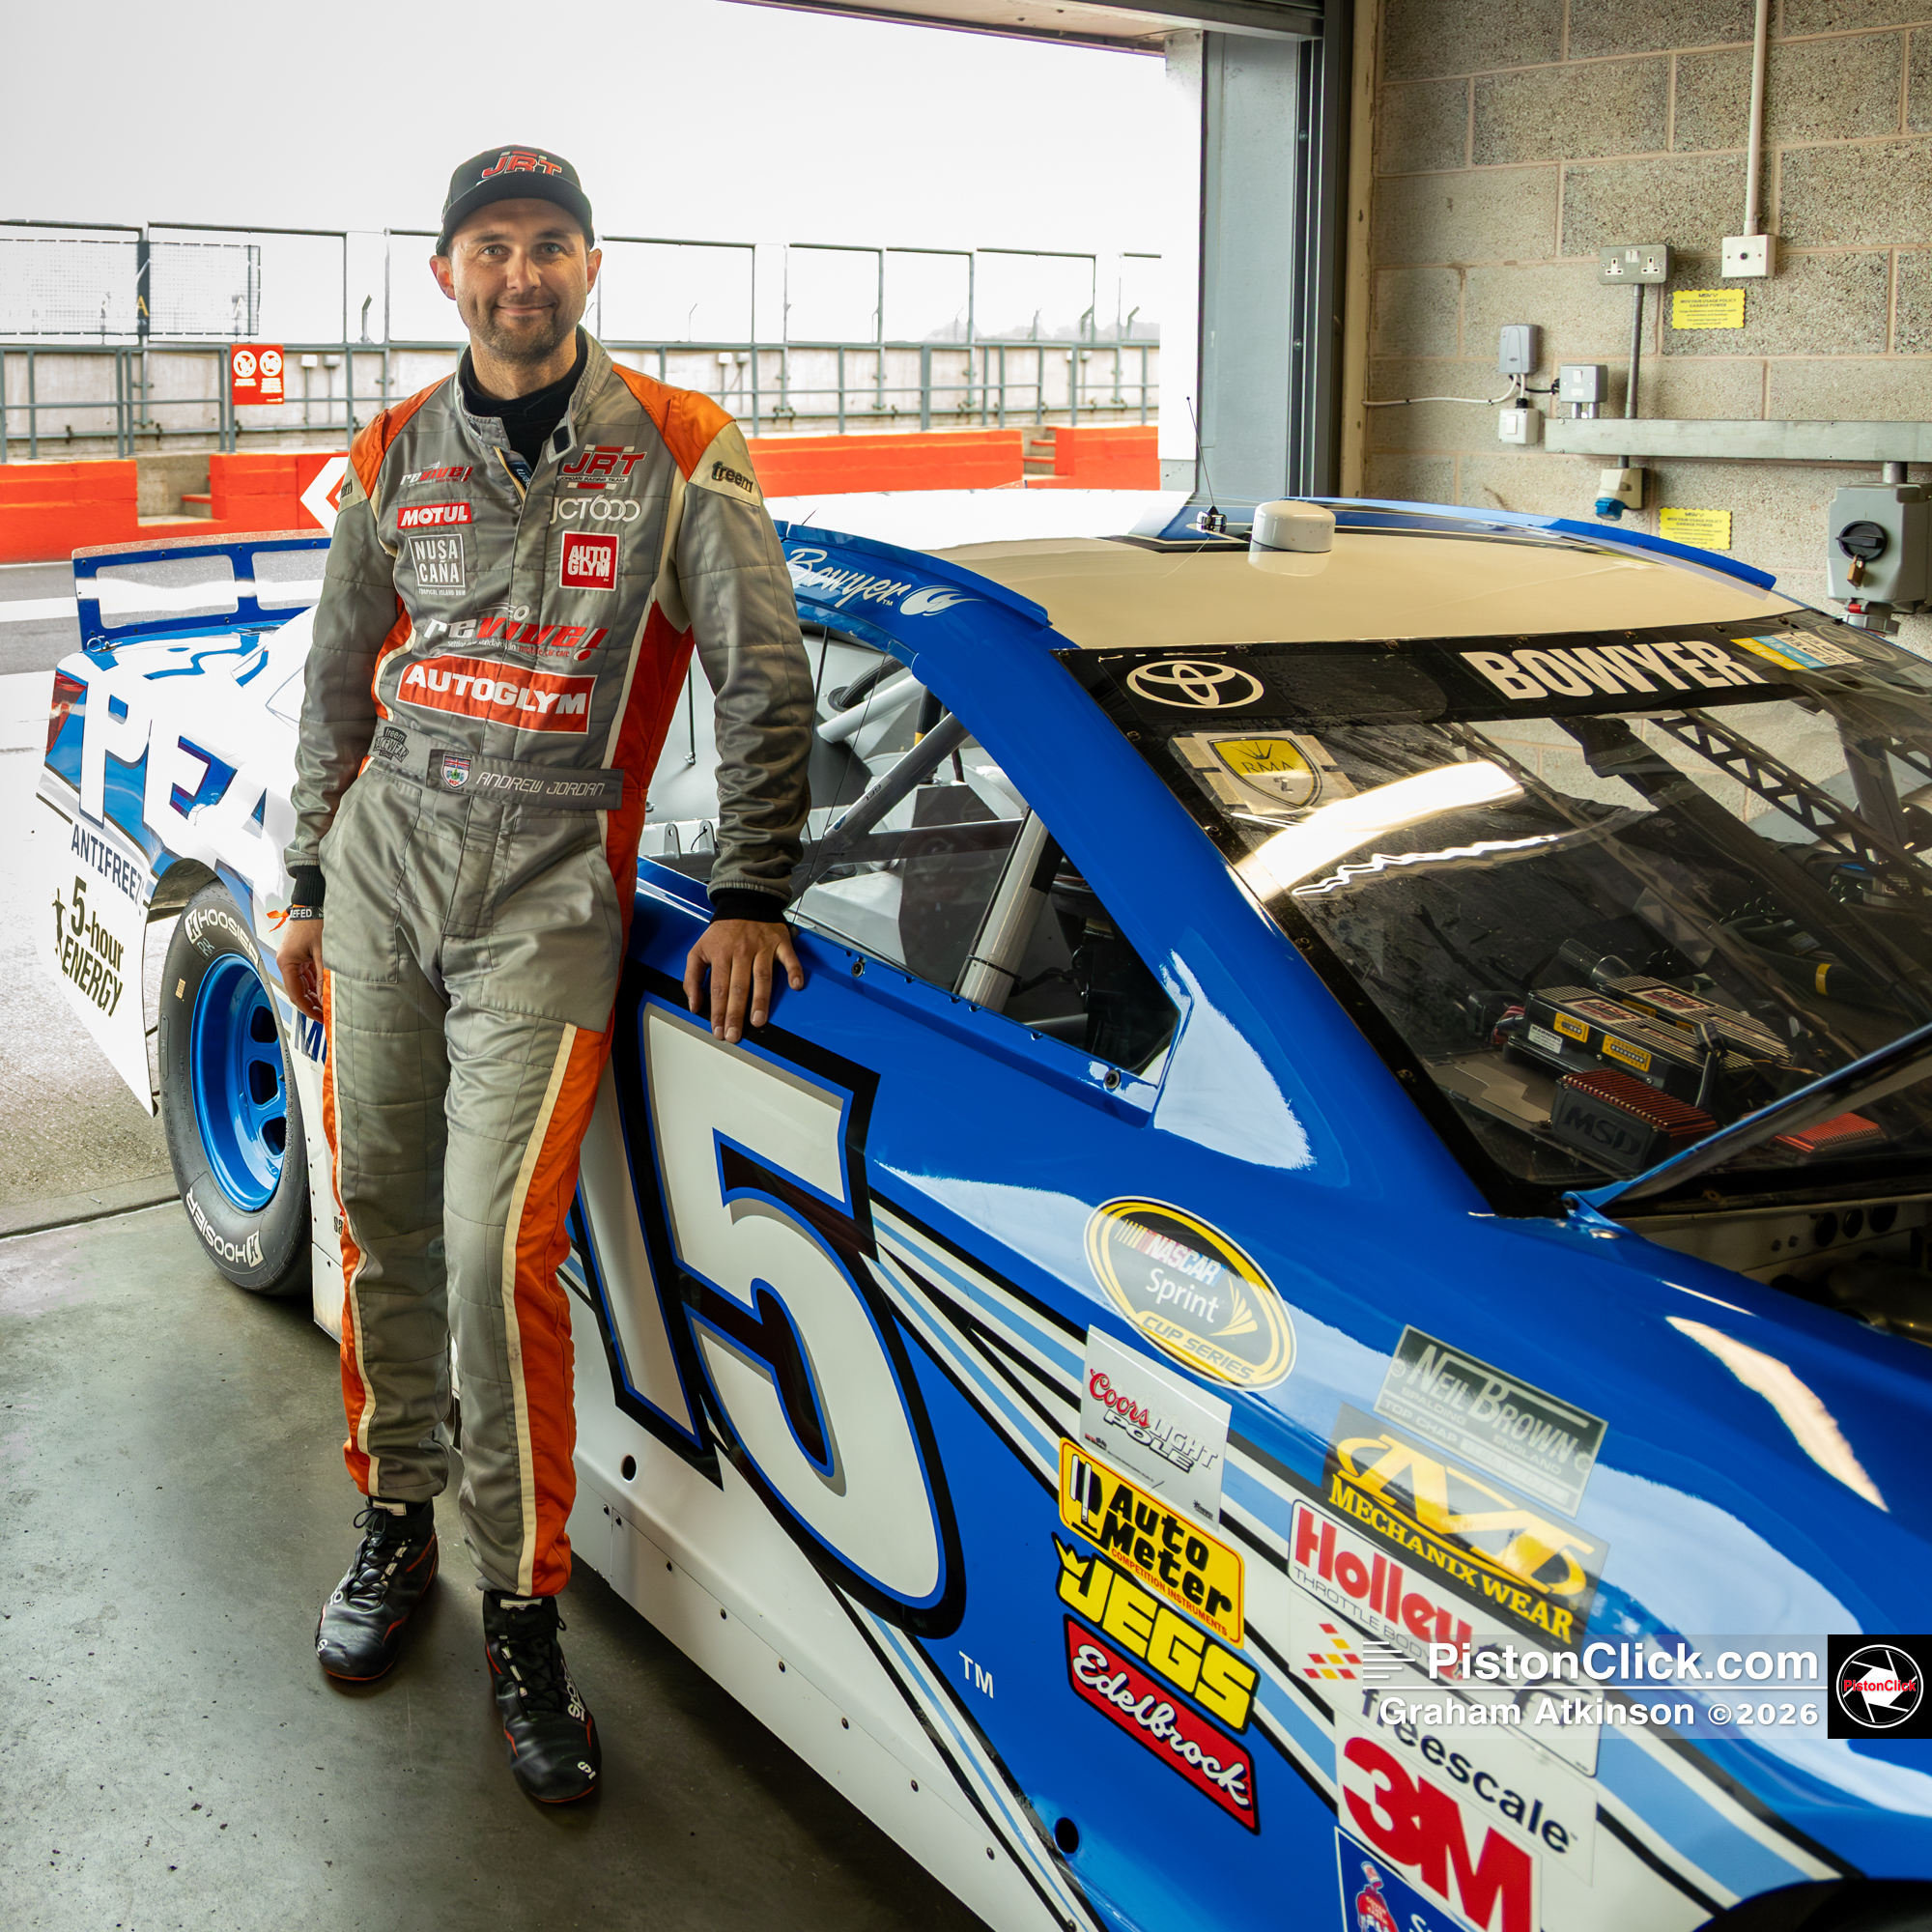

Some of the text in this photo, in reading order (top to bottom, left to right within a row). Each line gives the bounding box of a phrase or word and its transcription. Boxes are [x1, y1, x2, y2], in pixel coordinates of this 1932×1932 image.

[481, 155, 562, 179] JRT
[399, 466, 473, 485] revive!
[562, 451, 647, 475] JRT
[712, 460, 753, 494] freem
[400, 504, 469, 526] MOTUL
[550, 495, 640, 525] JCT600
[414, 539, 459, 560] NUSA
[418, 559, 460, 583] CAÑA
[567, 559, 610, 577] GLYM
[568, 545, 611, 562] AUTO
[785, 548, 912, 609] Bowyer TM
[423, 616, 609, 662] revive!
[405, 665, 587, 715] AUTOGLYM
[1460, 640, 1769, 700] BOWYER
[475, 772, 606, 797] ANDREW JORDAN
[1241, 760, 1294, 774] RMA
[71, 823, 144, 913] ANTIFREEZ
[71, 875, 124, 973] 5-hour
[199, 908, 259, 967] HOOSIER
[62, 934, 124, 1017] ENERGY
[1532, 1024, 1562, 1043] WARNING
[1564, 1105, 1641, 1155] MSD
[185, 1186, 247, 1264] HOOSIER
[1145, 1235, 1222, 1287] NASCAR
[572, 995, 952, 1623] 15
[1146, 1267, 1219, 1323] Sprint
[1142, 1316, 1255, 1379] CUP SERIES
[1089, 1368, 1151, 1430] Coors
[1149, 1418, 1219, 1469] LIGHT
[1382, 1399, 1413, 1420] TOP
[1401, 1387, 1467, 1427] SPALDING
[1492, 1434, 1563, 1476] ENGLAND
[1103, 1408, 1195, 1474] POLE
[1108, 1483, 1209, 1573] Auto
[1099, 1509, 1233, 1618] Meter
[1328, 1473, 1575, 1645] MECHANIX WEAR
[1111, 1548, 1228, 1637] COMPETITION INSTRUMENTS
[1293, 1565, 1380, 1632] THROTTLE
[1294, 1505, 1472, 1681] Holley
[1059, 1557, 1257, 1730] JEGS
[958, 1650, 994, 1699] TM
[1072, 1643, 1252, 1808] Edelbrock
[1362, 1689, 1570, 1855] freescale
[1343, 1736, 1533, 1932] 3M
